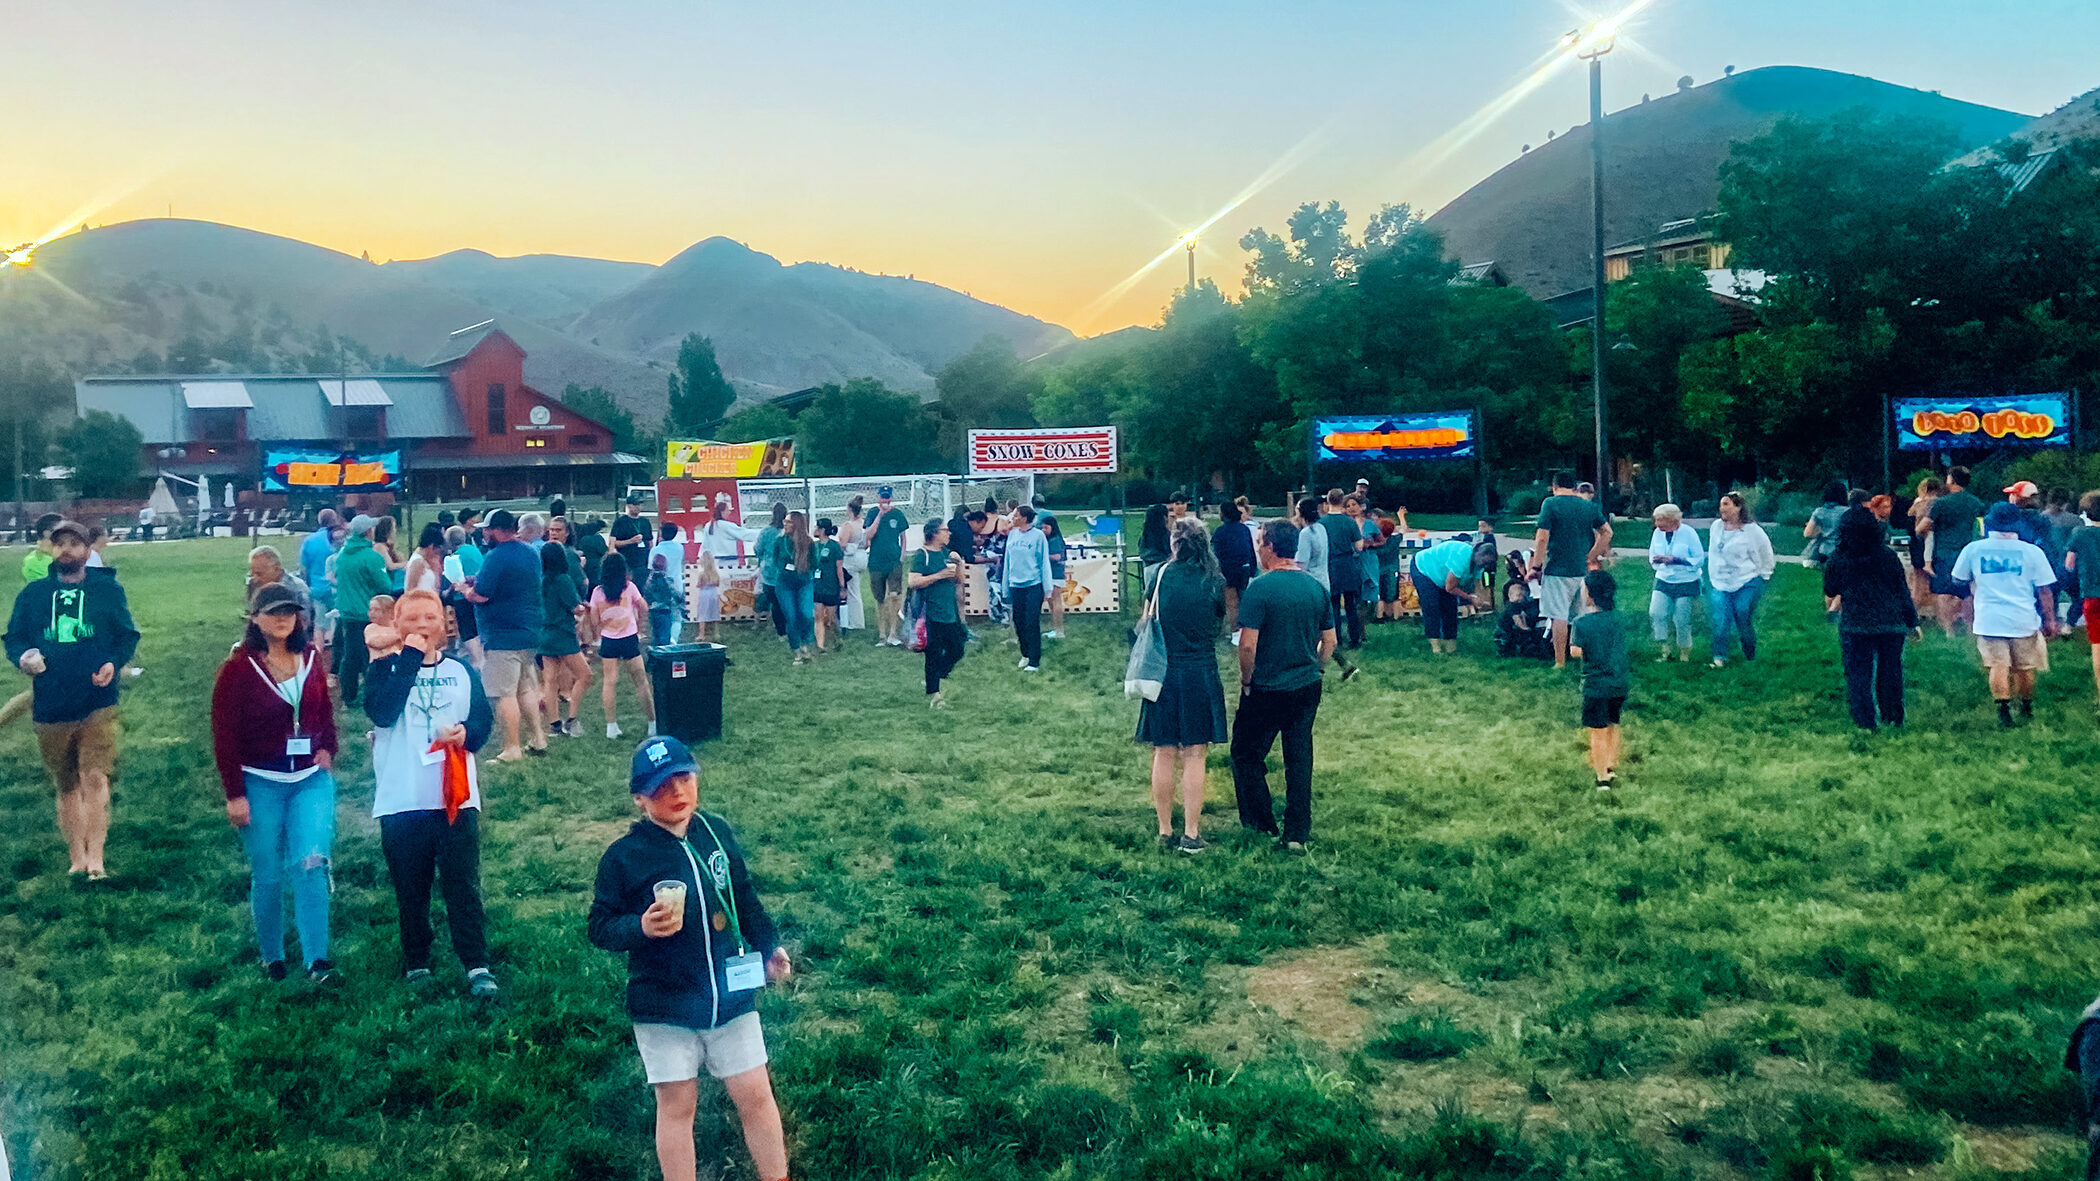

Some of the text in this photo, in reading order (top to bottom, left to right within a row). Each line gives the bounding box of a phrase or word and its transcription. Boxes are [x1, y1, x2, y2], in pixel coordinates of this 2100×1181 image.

[1986, 412, 2048, 436] TOSS
[988, 442, 1098, 460] SNOW CONES
